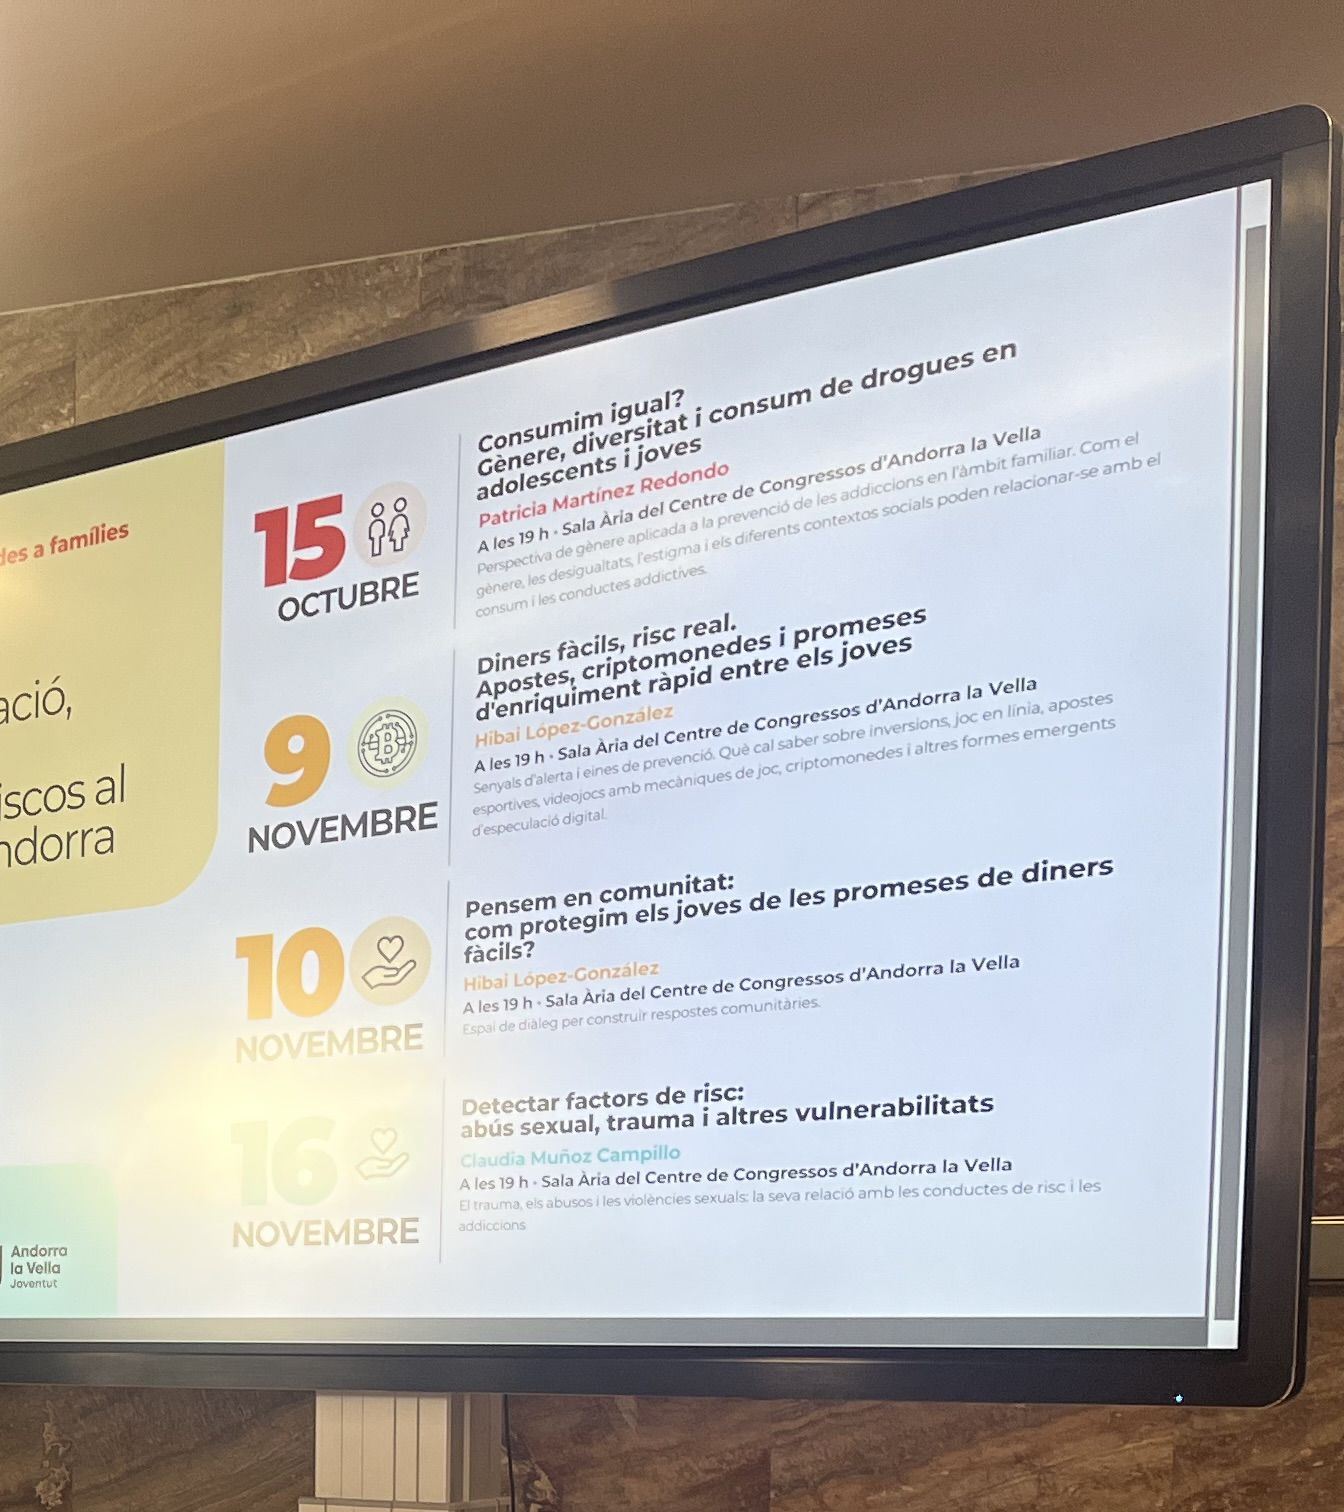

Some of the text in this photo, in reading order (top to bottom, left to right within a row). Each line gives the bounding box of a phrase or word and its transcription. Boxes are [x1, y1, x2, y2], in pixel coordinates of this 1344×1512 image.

[477, 342, 1016, 477] Gènere, diversitat i consum de drogues en
[478, 389, 685, 453] Consumim igual?
[476, 437, 703, 501] adolescents i joves
[477, 426, 1041, 554] A les 19 h Sala Ària del Centre de Congressos d'Andorra la Vella
[479, 461, 729, 528] Patricia Martínez Redondo
[33, 543, 44, 559] a
[49, 522, 129, 555] famílies
[254, 494, 346, 587] 15
[278, 571, 419, 622] OCTUBRE
[475, 608, 926, 700] Apostes, criptomonedes i promeses
[477, 612, 737, 675] Diners fàcils, risc real.
[475, 636, 913, 721] d'enriquiment ràpid entre els joves
[474, 677, 1037, 773] A les 19 h Sala Ària del Centre de Congressos d'Andorra la Vella
[475, 704, 673, 749] Hibai López-González
[94, 763, 126, 806] al
[264, 714, 331, 807] 9
[248, 801, 438, 853] NOVEMBRE
[464, 859, 1114, 941] com protegim els joves de les promeses de diners
[466, 873, 734, 918] Pensem en comunitat:
[235, 927, 345, 1020] 10
[463, 940, 535, 964] fàcils?
[463, 960, 659, 992] Hibai López-González
[235, 1023, 424, 1064] NOVEMBRE
[460, 1095, 994, 1139] abús sexual, trauma i altres vulnerabilitats
[462, 1082, 745, 1116] Detectar factors de risc:
[231, 1116, 338, 1206] 16
[460, 1143, 681, 1168] Claudia Muñoz Campillo
[10, 1244, 68, 1258] Andorra
[232, 1216, 420, 1248] NOVEMBRE
[10, 1261, 61, 1275] la Vella
[10, 1278, 58, 1289] Joventut
